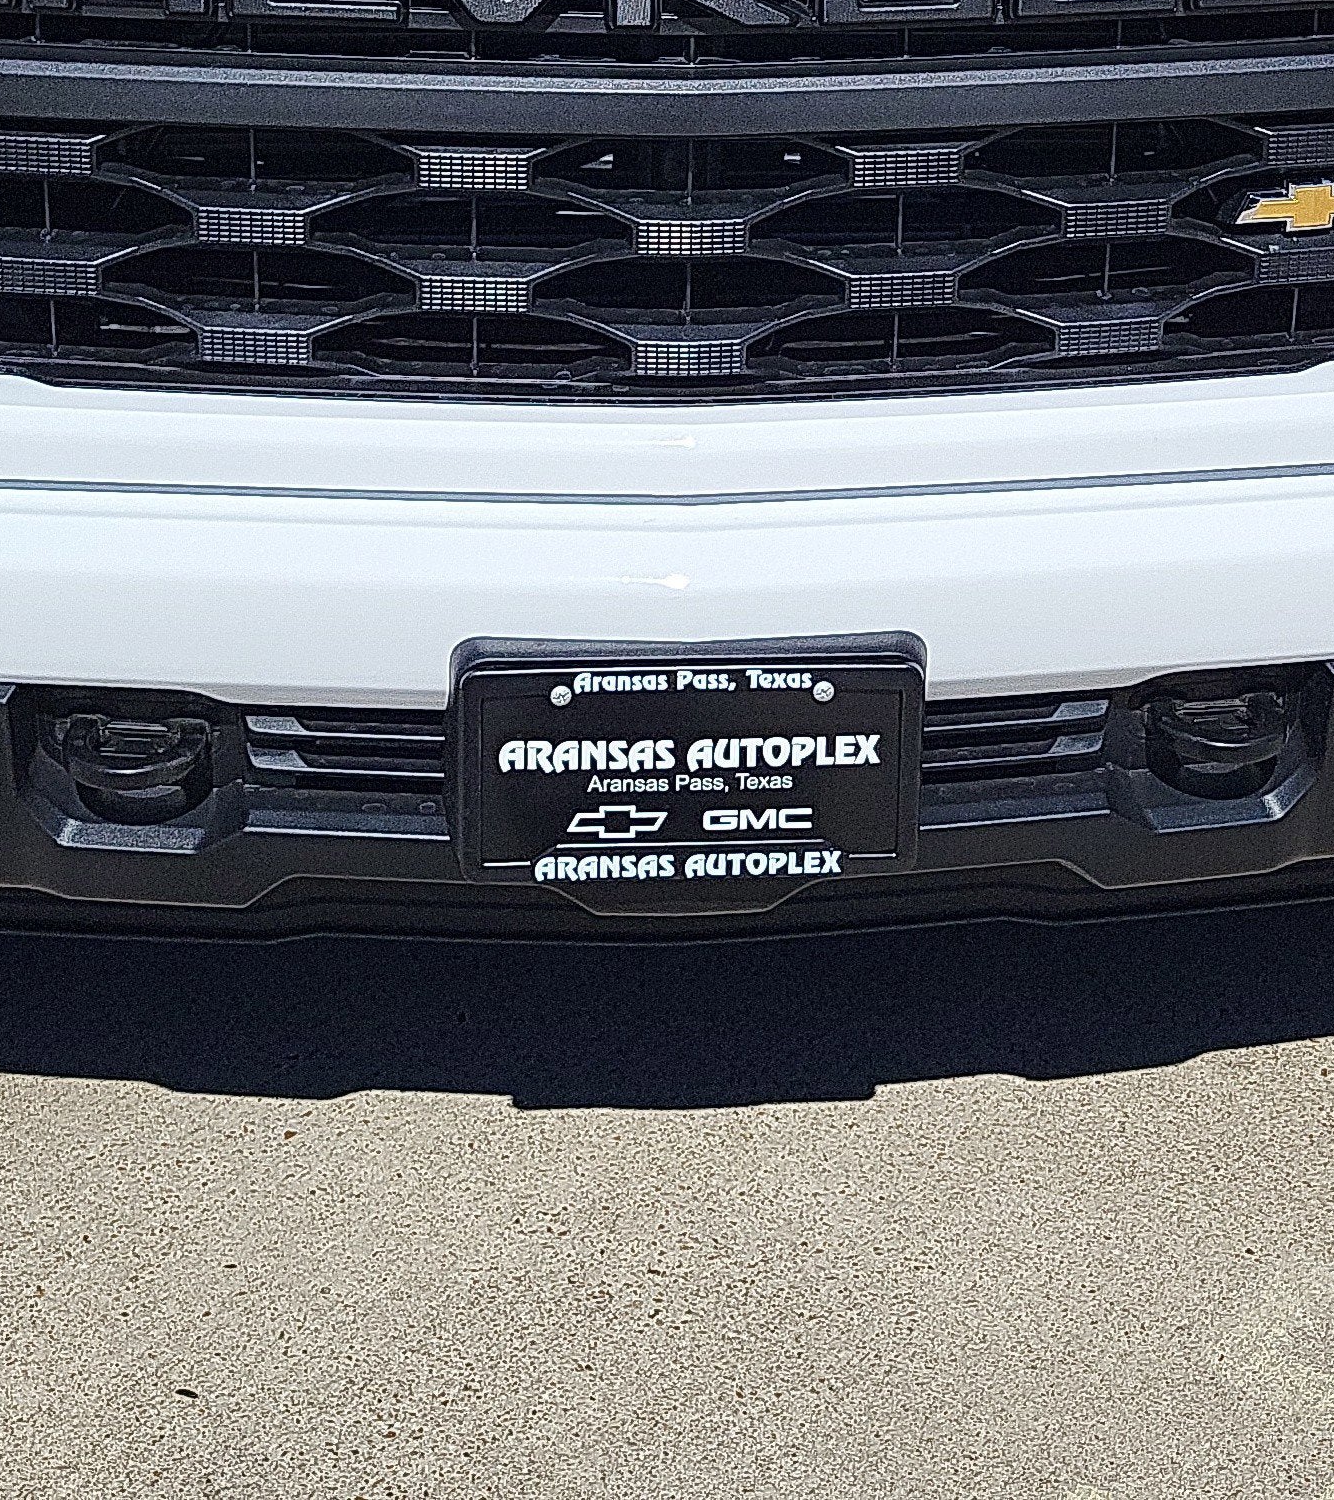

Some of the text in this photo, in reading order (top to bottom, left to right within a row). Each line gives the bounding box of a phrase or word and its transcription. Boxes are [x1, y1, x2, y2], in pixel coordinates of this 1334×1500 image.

[572, 668, 813, 694] Aransas Pass, Texas
[498, 735, 881, 773] ARANSAS AUTOPLEX
[586, 773, 793, 793] Aransas Pass, Texas
[702, 808, 813, 831] GMC
[535, 849, 842, 881] ARANSAS AUTOPLEX
